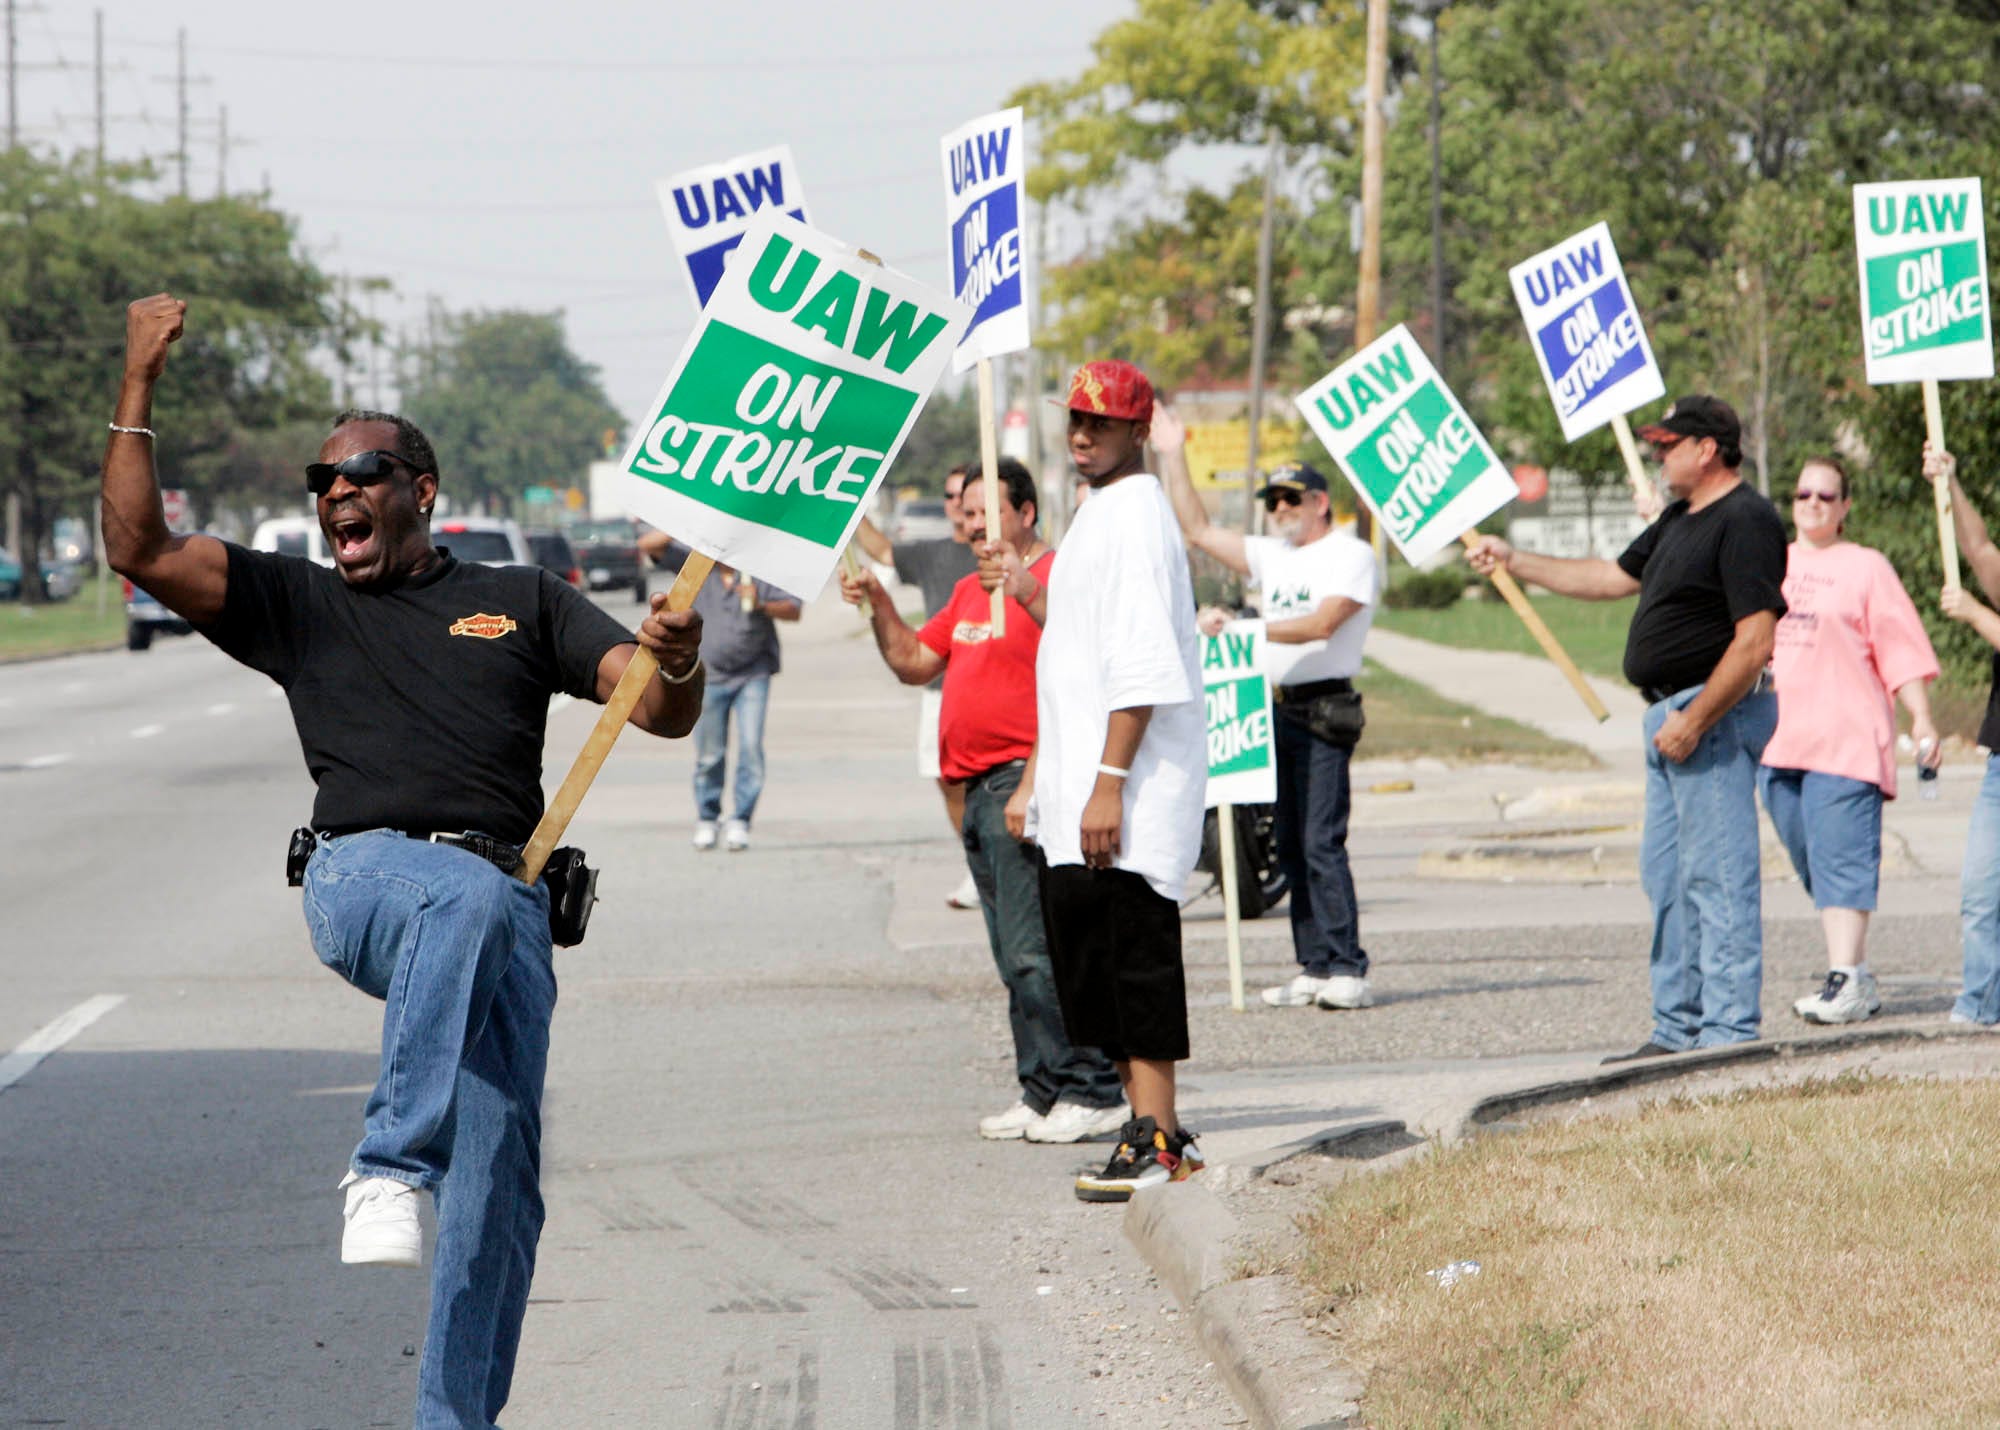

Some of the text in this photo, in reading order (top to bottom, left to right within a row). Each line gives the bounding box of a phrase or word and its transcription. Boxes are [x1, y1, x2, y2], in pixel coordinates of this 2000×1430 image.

[672, 162, 785, 229] UAW
[950, 126, 1011, 196] UAW
[963, 201, 988, 263] ON
[1868, 192, 1969, 237] UAW
[747, 232, 950, 375] UAW
[1523, 239, 1604, 307] UAW
[1897, 247, 1944, 301] ON
[1561, 296, 1602, 357] ON
[1870, 275, 1983, 357] STRIKE
[735, 361, 844, 433] ON
[1314, 341, 1416, 432] UAW
[1556, 310, 1639, 417] STRIKE
[635, 416, 884, 504] STRIKE
[1377, 407, 1425, 475] ON
[1381, 410, 1474, 539] STRIKE
[1197, 633, 1255, 669] AW
